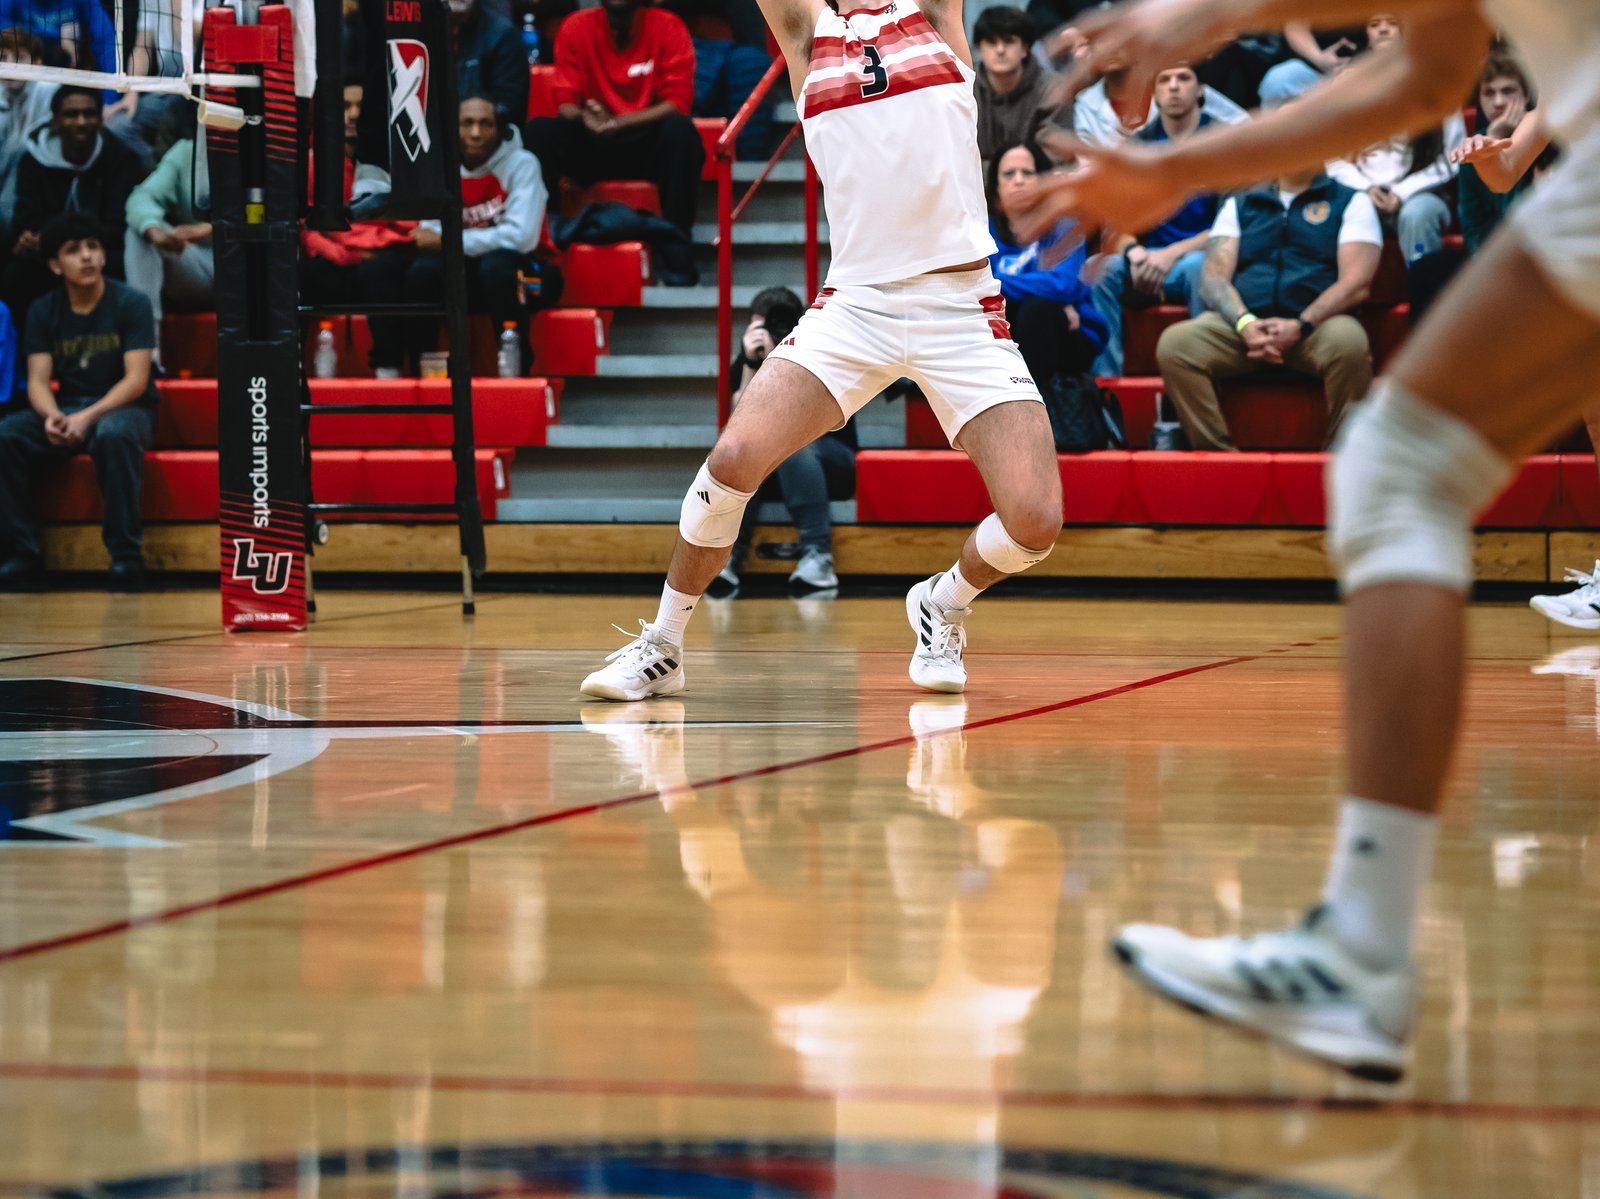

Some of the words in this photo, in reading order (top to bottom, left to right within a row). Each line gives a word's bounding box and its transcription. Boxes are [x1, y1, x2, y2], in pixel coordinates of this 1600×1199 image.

[860, 44, 889, 98] 3
[248, 376, 269, 443] sports
[249, 445, 271, 529] imports
[232, 538, 292, 594] LU
